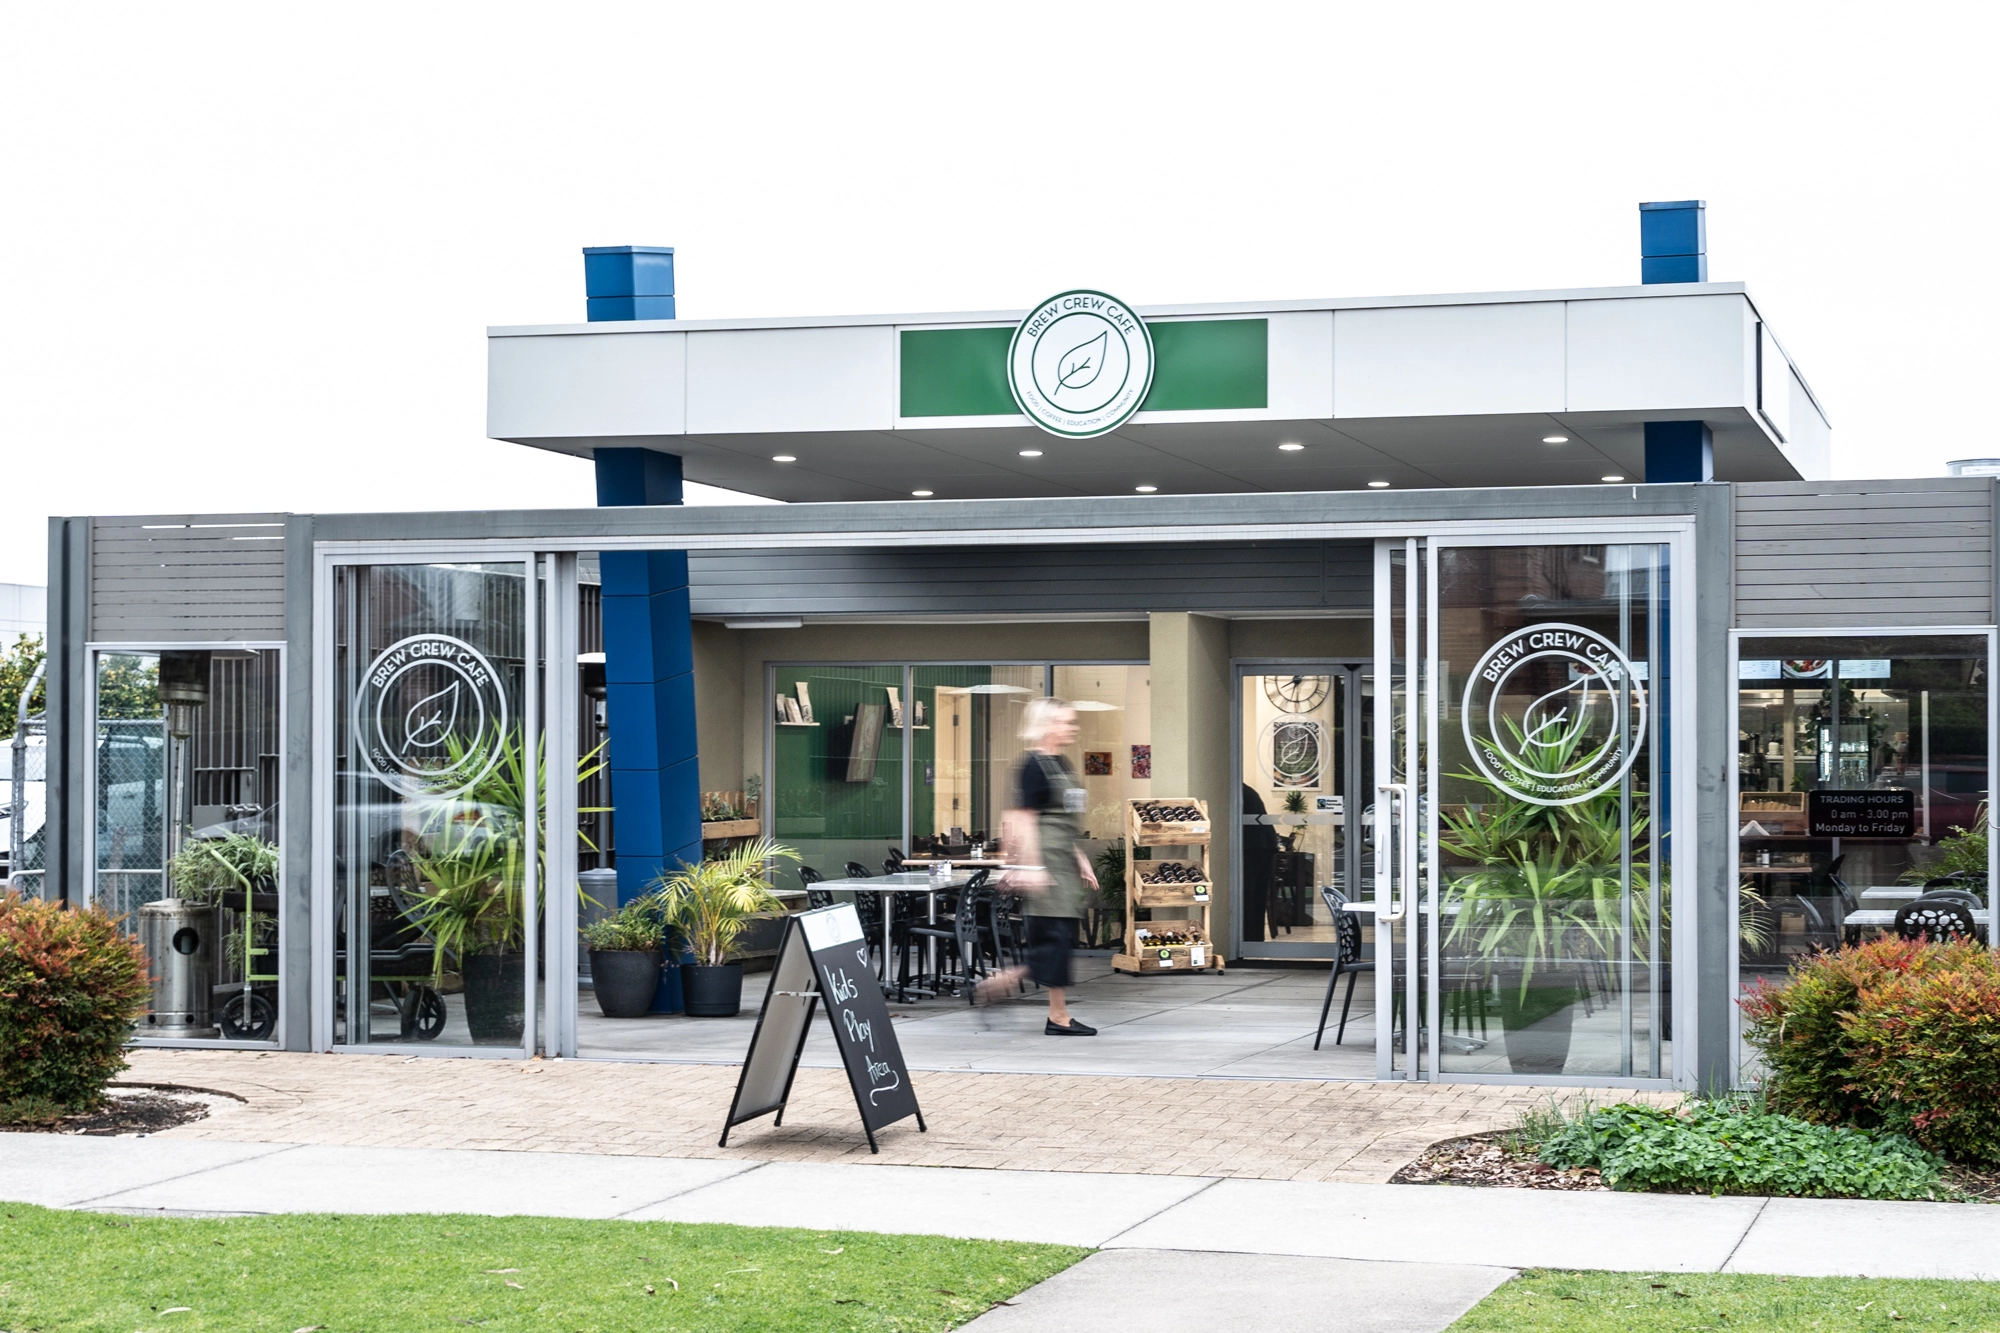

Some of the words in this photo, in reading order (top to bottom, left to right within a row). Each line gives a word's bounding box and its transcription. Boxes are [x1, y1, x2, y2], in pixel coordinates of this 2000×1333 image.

[1026, 304, 1058, 337] BREW
[1063, 298, 1105, 310] CREW
[1107, 306, 1135, 335] CAFE
[1027, 391, 1039, 407] FOOD
[1042, 409, 1062, 422] COFFEE
[1067, 417, 1102, 426] EDUCATION
[1106, 388, 1134, 418] COMMUNITY
[372, 649, 406, 688] BREW
[410, 642, 456, 658] CREW
[457, 653, 490, 688] CAFE
[1483, 639, 1523, 683] BREW
[1529, 632, 1585, 650] CREW
[1483, 748, 1500, 769] FOOD
[1504, 770, 1531, 789] COFFEE
[1537, 783, 1582, 793] EDUCATION
[1586, 747, 1623, 784] COMMUNITY
[1816, 823, 1856, 834] Monday
[1872, 823, 1905, 834] Friday
[1867, 810, 1889, 818] 3.00
[1892, 811, 1908, 820] pm
[823, 964, 859, 1005] Kids
[843, 1008, 874, 1052] Play
[865, 1055, 890, 1085] Area
